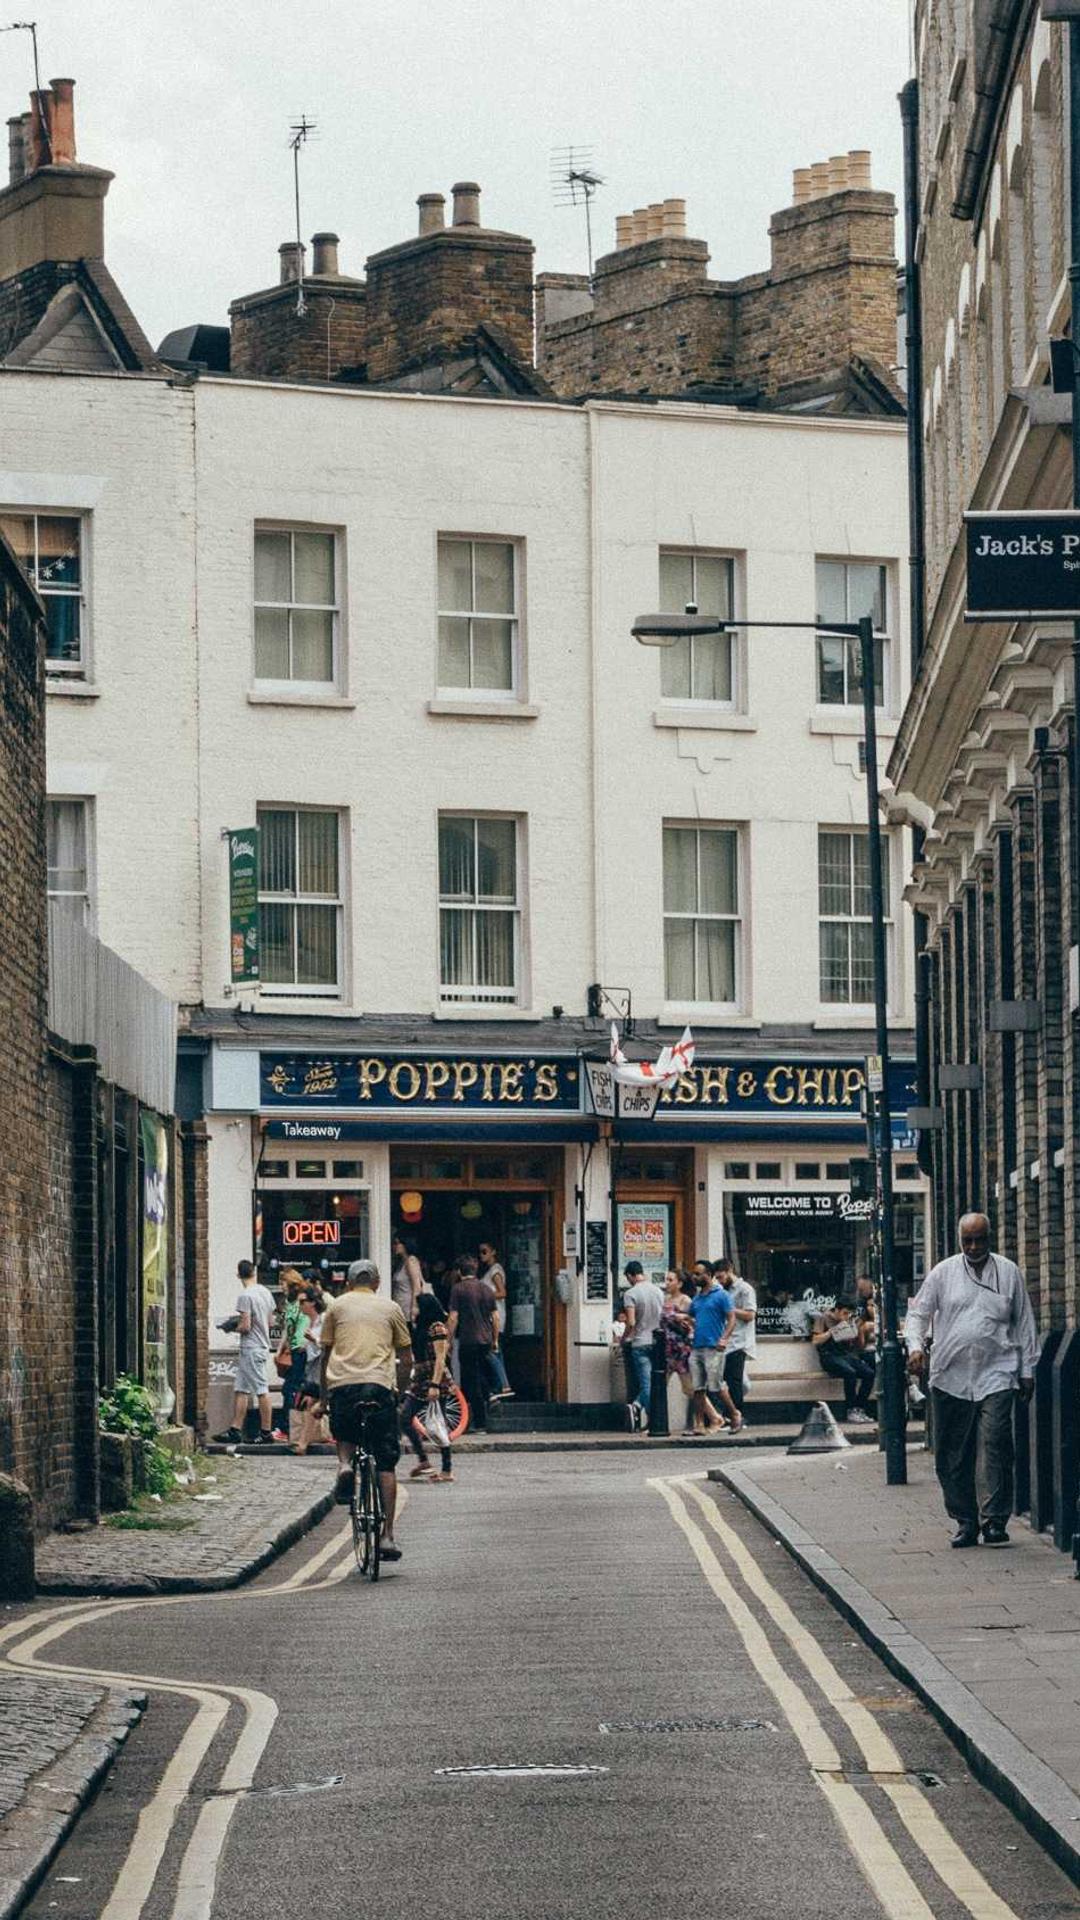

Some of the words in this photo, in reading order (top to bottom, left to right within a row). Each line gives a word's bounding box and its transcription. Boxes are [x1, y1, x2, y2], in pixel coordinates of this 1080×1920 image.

[976, 534, 1053, 556] Jack's
[1061, 534, 1080, 555] P
[360, 1059, 559, 1102] POPPIE'S
[736, 1071, 757, 1097] &
[763, 1065, 866, 1106] CHIP
[624, 1097, 651, 1112] CHIPS
[282, 1122, 341, 1140] Takeaway
[748, 1196, 811, 1208] WELCOME
[814, 1196, 832, 1208] TO
[285, 1222, 338, 1243] OPEN
